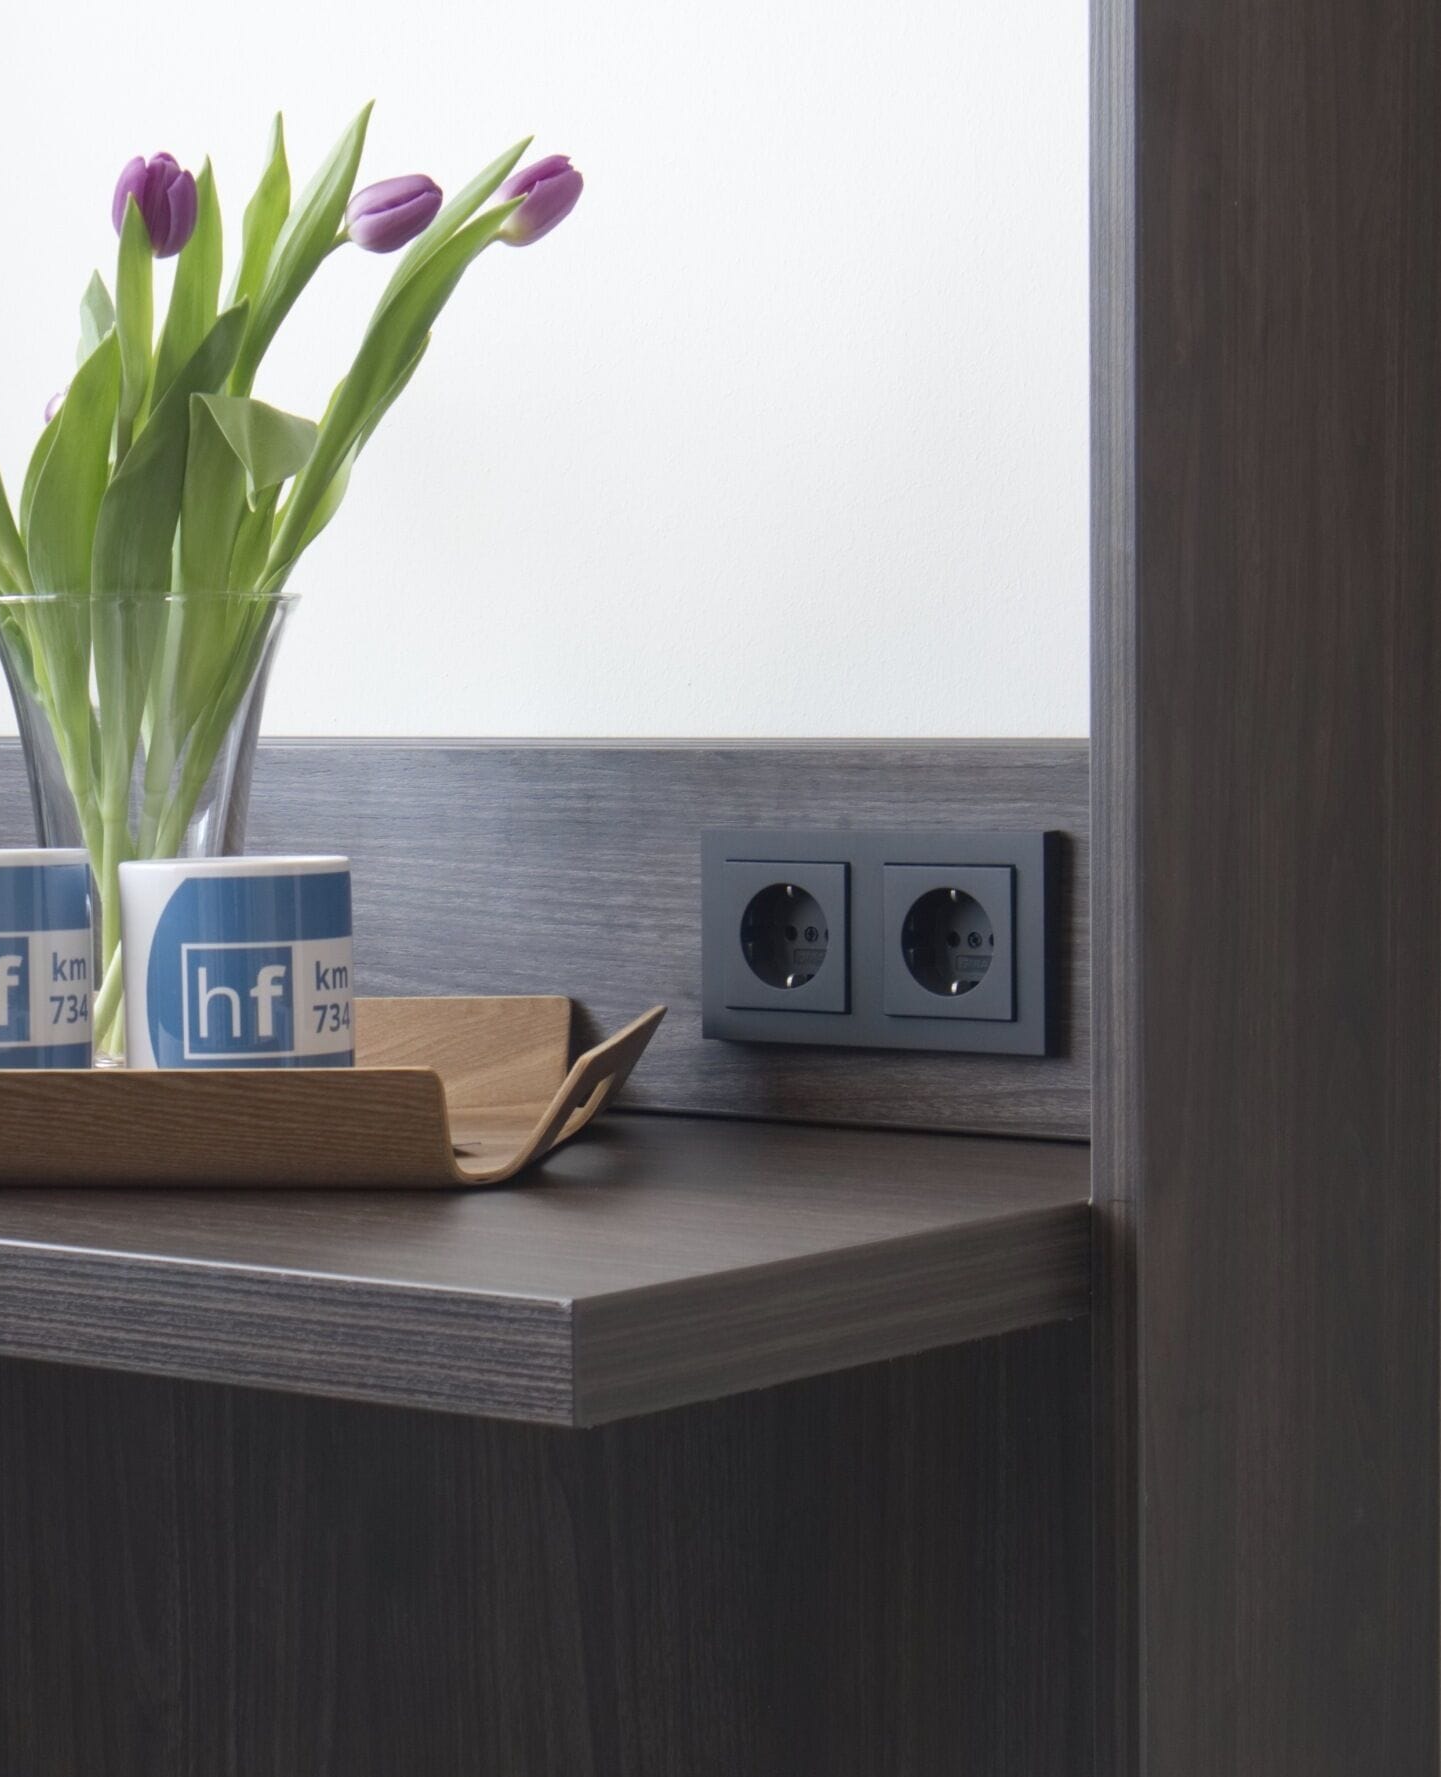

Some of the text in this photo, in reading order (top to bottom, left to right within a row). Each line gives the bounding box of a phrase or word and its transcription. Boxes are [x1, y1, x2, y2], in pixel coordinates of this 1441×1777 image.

[52, 952, 87, 982] km
[315, 961, 348, 991] km
[49, 995, 88, 1025] 734
[198, 965, 287, 1038] hf
[313, 1002, 350, 1033] 734
